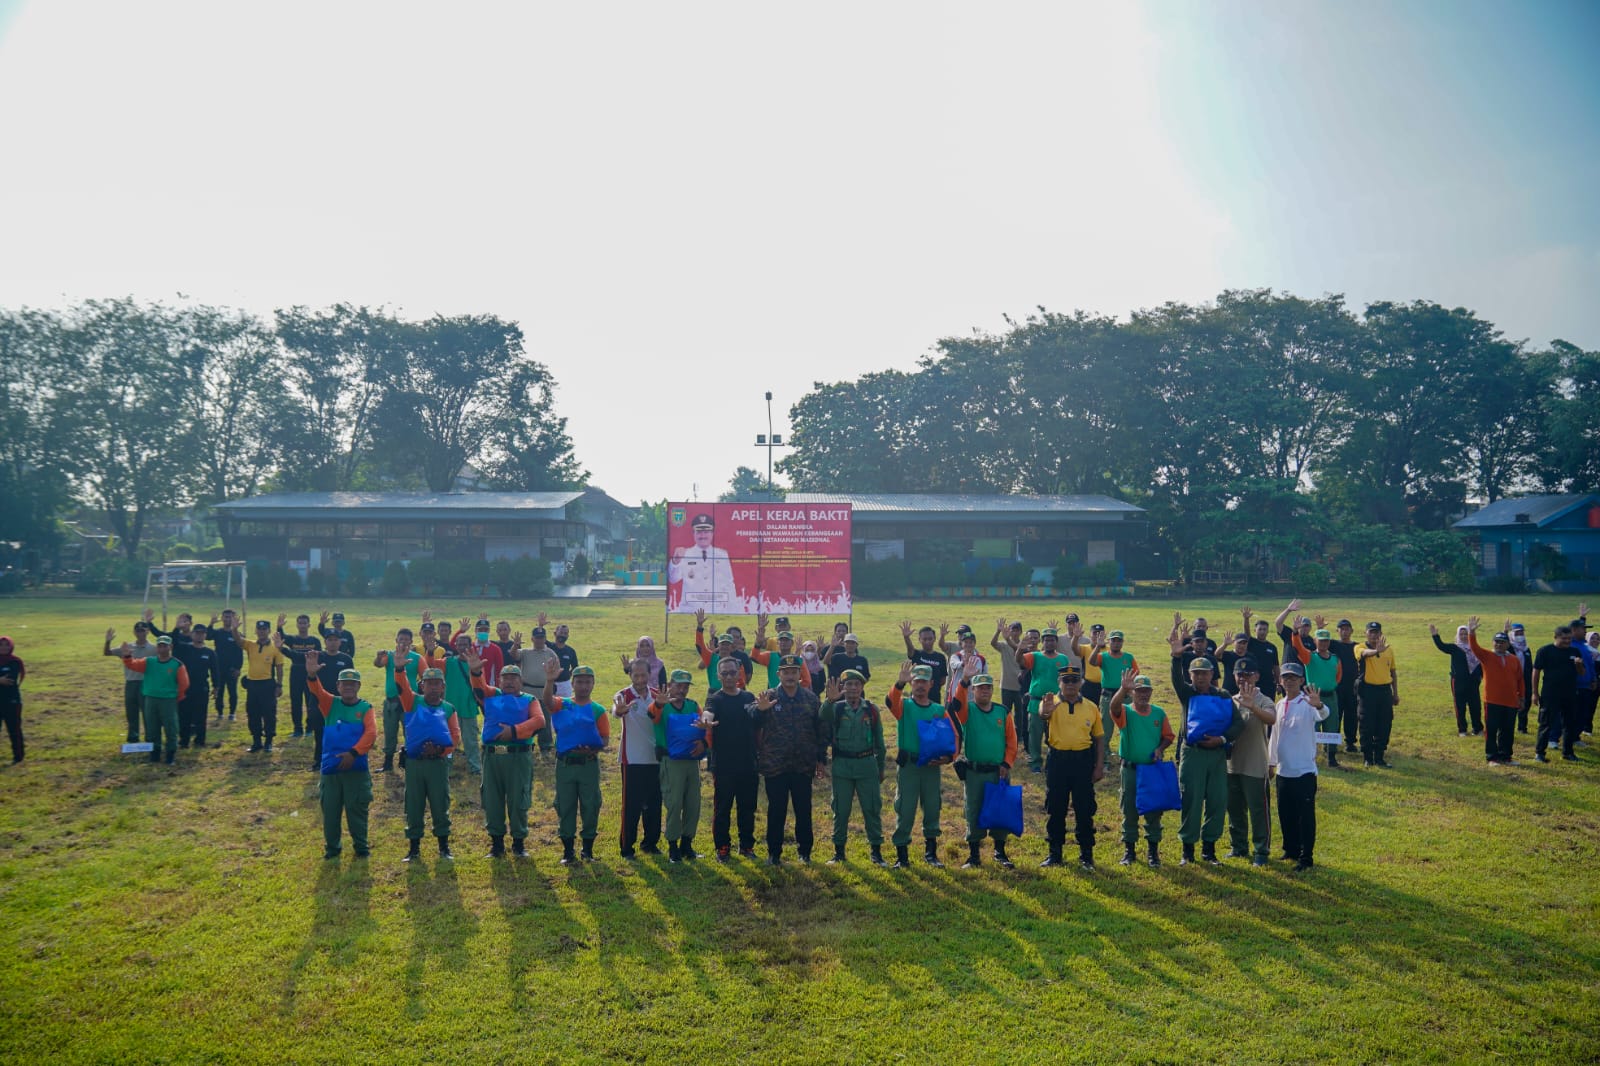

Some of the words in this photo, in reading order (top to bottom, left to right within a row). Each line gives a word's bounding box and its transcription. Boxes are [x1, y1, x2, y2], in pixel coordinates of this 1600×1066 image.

[731, 510, 763, 521] APEL
[767, 510, 806, 521] KERJA
[810, 510, 848, 521] BAKTI
